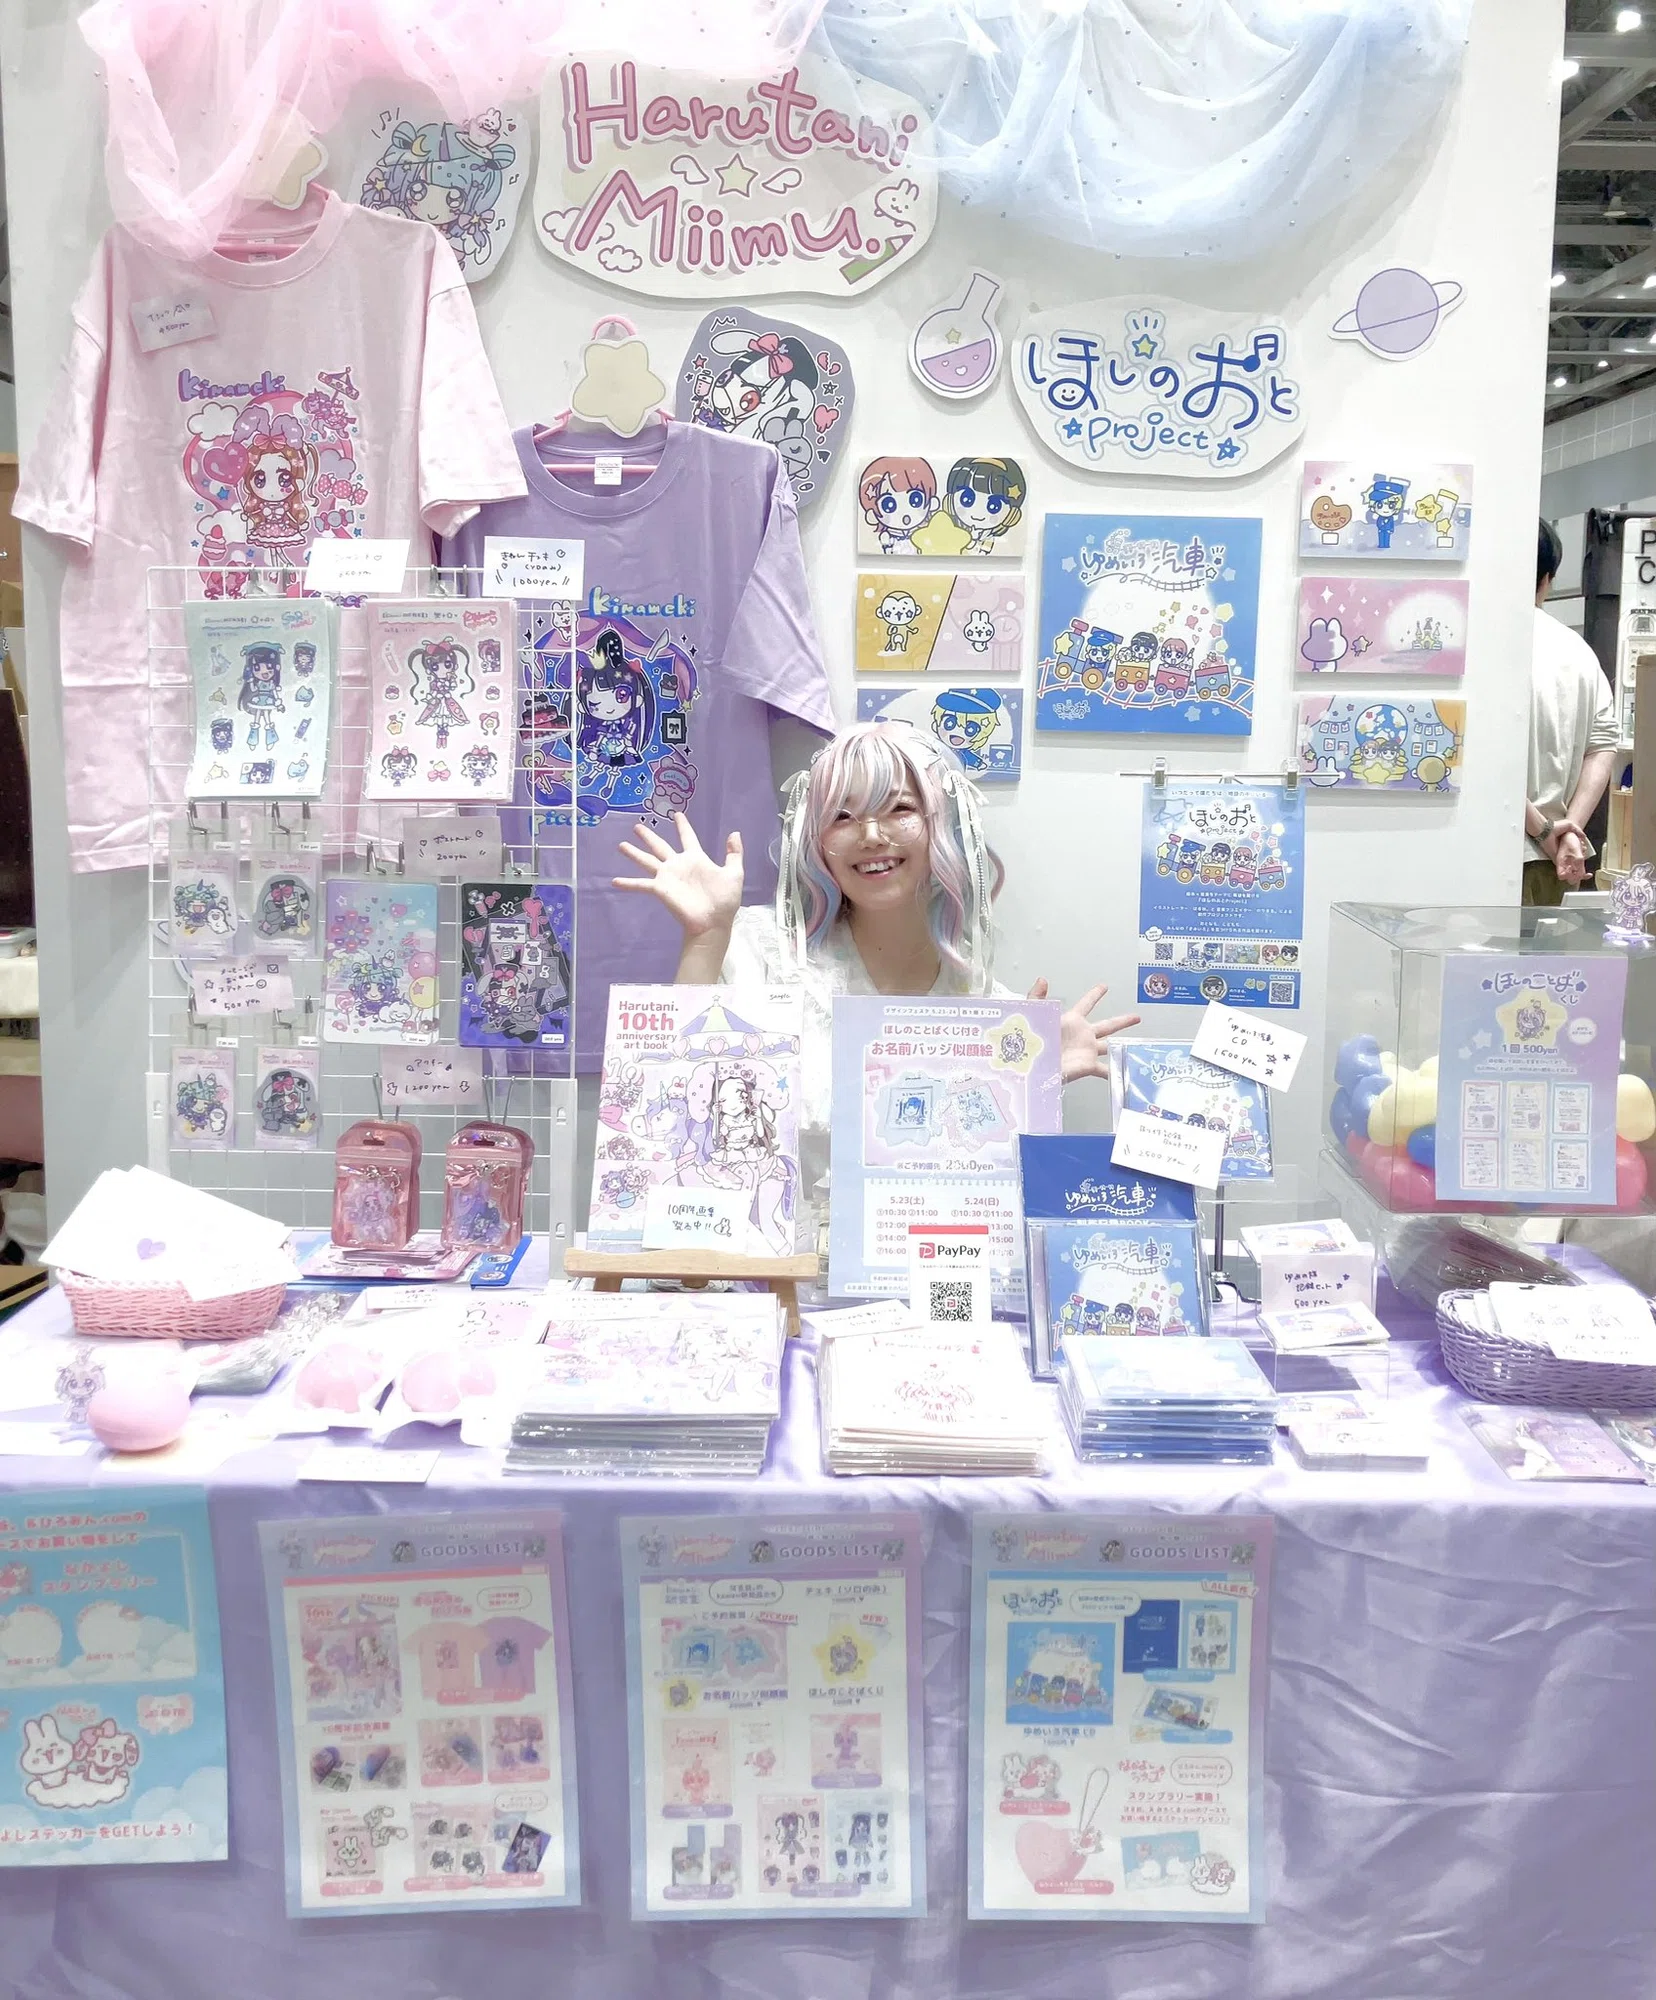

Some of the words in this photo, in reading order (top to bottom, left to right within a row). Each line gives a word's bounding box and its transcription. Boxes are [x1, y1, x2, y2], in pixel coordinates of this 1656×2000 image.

[562, 61, 918, 171] Harutani
[1028, 333, 1292, 430] ほしのおと
[1081, 536, 1207, 577] ゆめいろ汽車
[1188, 804, 1256, 828] ほしのおと
[618, 1000, 679, 1012] Harutani.
[618, 1012, 675, 1031] 10th
[616, 1032, 678, 1043] anniversary
[883, 1025, 980, 1037] ほしのことばくじ付き
[623, 1041, 642, 1050] art
[643, 1040, 668, 1050] book
[871, 1042, 994, 1057] お名前バッジ似顔絵
[1152, 1062, 1234, 1079] ゆめいろ汽
[890, 1196, 925, 1206] 5.23(土)
[1064, 1181, 1146, 1207] ゆめいろ汽車
[964, 1197, 1000, 1207] 5.24(日)
[937, 1244, 981, 1258] PayPay
[1073, 1238, 1161, 1265] ゆめいろ汽車
[420, 1543, 478, 1557] GOODS
[485, 1541, 520, 1556] LIST
[779, 1546, 837, 1558] GOODS
[843, 1544, 880, 1557] LIST
[1130, 1547, 1187, 1559] GOODS
[1194, 1547, 1230, 1559] LIST
